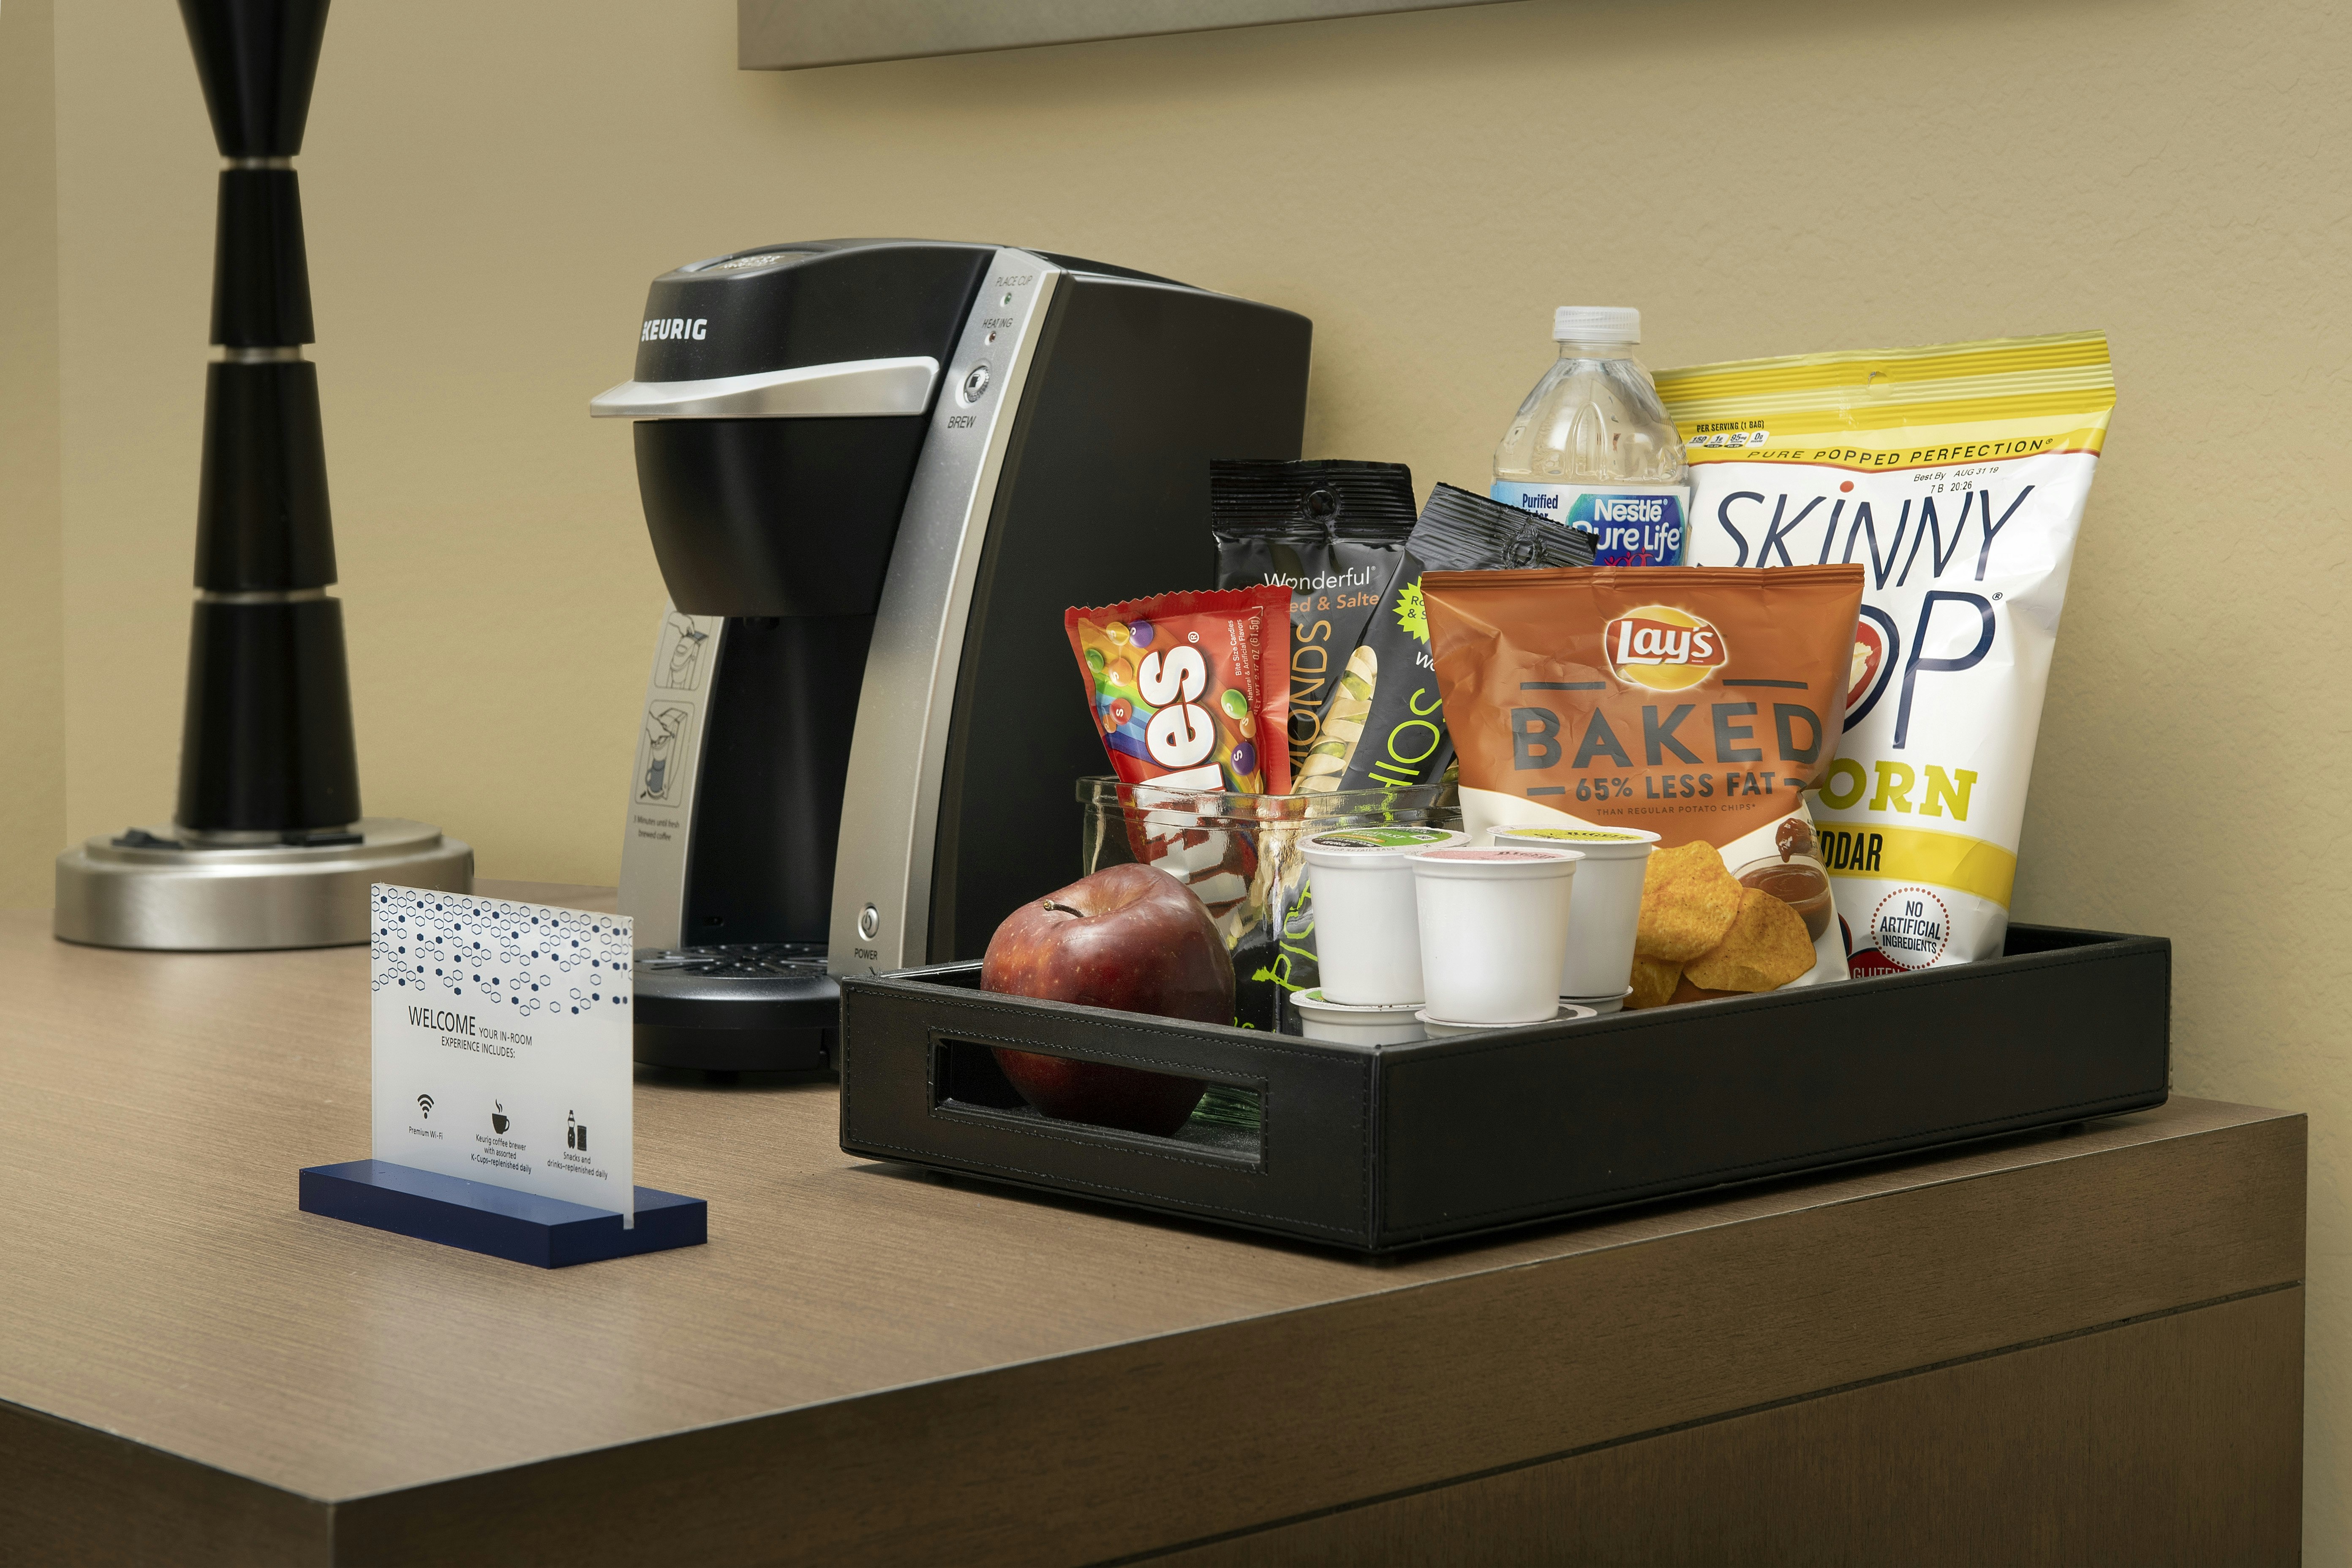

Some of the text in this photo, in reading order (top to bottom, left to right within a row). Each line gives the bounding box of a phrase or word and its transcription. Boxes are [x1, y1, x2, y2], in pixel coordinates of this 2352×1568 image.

[996, 275, 1033, 287] PLACE CUP
[641, 318, 708, 342] KEURIG
[982, 318, 1013, 329] HEATING
[947, 416, 977, 429] BREW
[1697, 424, 1710, 433] PER
[1711, 422, 1739, 431] SERVING
[1749, 420, 1764, 429] BAG)
[1748, 440, 2044, 465] PURE POPPED PERFECTION
[1914, 474, 1933, 482] Best
[1934, 472, 1946, 480] By
[1953, 468, 1975, 477] AUG
[1938, 484, 1944, 493] B
[1950, 481, 1973, 492] 20:26
[1522, 493, 1559, 509] Purified
[1644, 522, 1680, 562] Life
[1264, 566, 1369, 590] Wonderful
[1317, 596, 1331, 611] &
[1337, 592, 1380, 609] Salte
[1228, 620, 1237, 646] Candies
[1237, 619, 1245, 642] Flavors
[1248, 616, 1261, 647] (61.5g)
[1616, 621, 1714, 665] Lay's
[1240, 642, 1250, 669] Artificial
[1252, 649, 1260, 661] OZ
[1245, 677, 1254, 701] Natural
[1255, 683, 1261, 696] WT
[1137, 644, 1226, 791] les
[1511, 702, 1823, 771] BAKED
[1576, 772, 1775, 802] 65% LESS FAT
[1818, 757, 1979, 822] ORN
[1596, 808, 1623, 816] THAN
[1628, 806, 1675, 815] REGULAR
[1678, 804, 1717, 814] POTATO
[1816, 830, 1884, 872] DDAR
[1906, 900, 1924, 917] NO
[1879, 916, 1941, 941] ARTIFICIAL
[1882, 934, 1937, 954] INGREDIENTS
[854, 948, 878, 960] POWER
[408, 1005, 532, 1046] WELCOME YOUR IN-ROOM
[441, 1036, 515, 1059] EXPERIENCE INCLUDES:
[409, 1126, 443, 1140] Premium Wi-Fi
[476, 1134, 526, 1151] Keurig coffee brewer
[484, 1146, 517, 1160] with assorted
[564, 1152, 591, 1164] Snacks and
[520, 1164, 532, 1175] daily
[596, 1169, 608, 1180] daily
